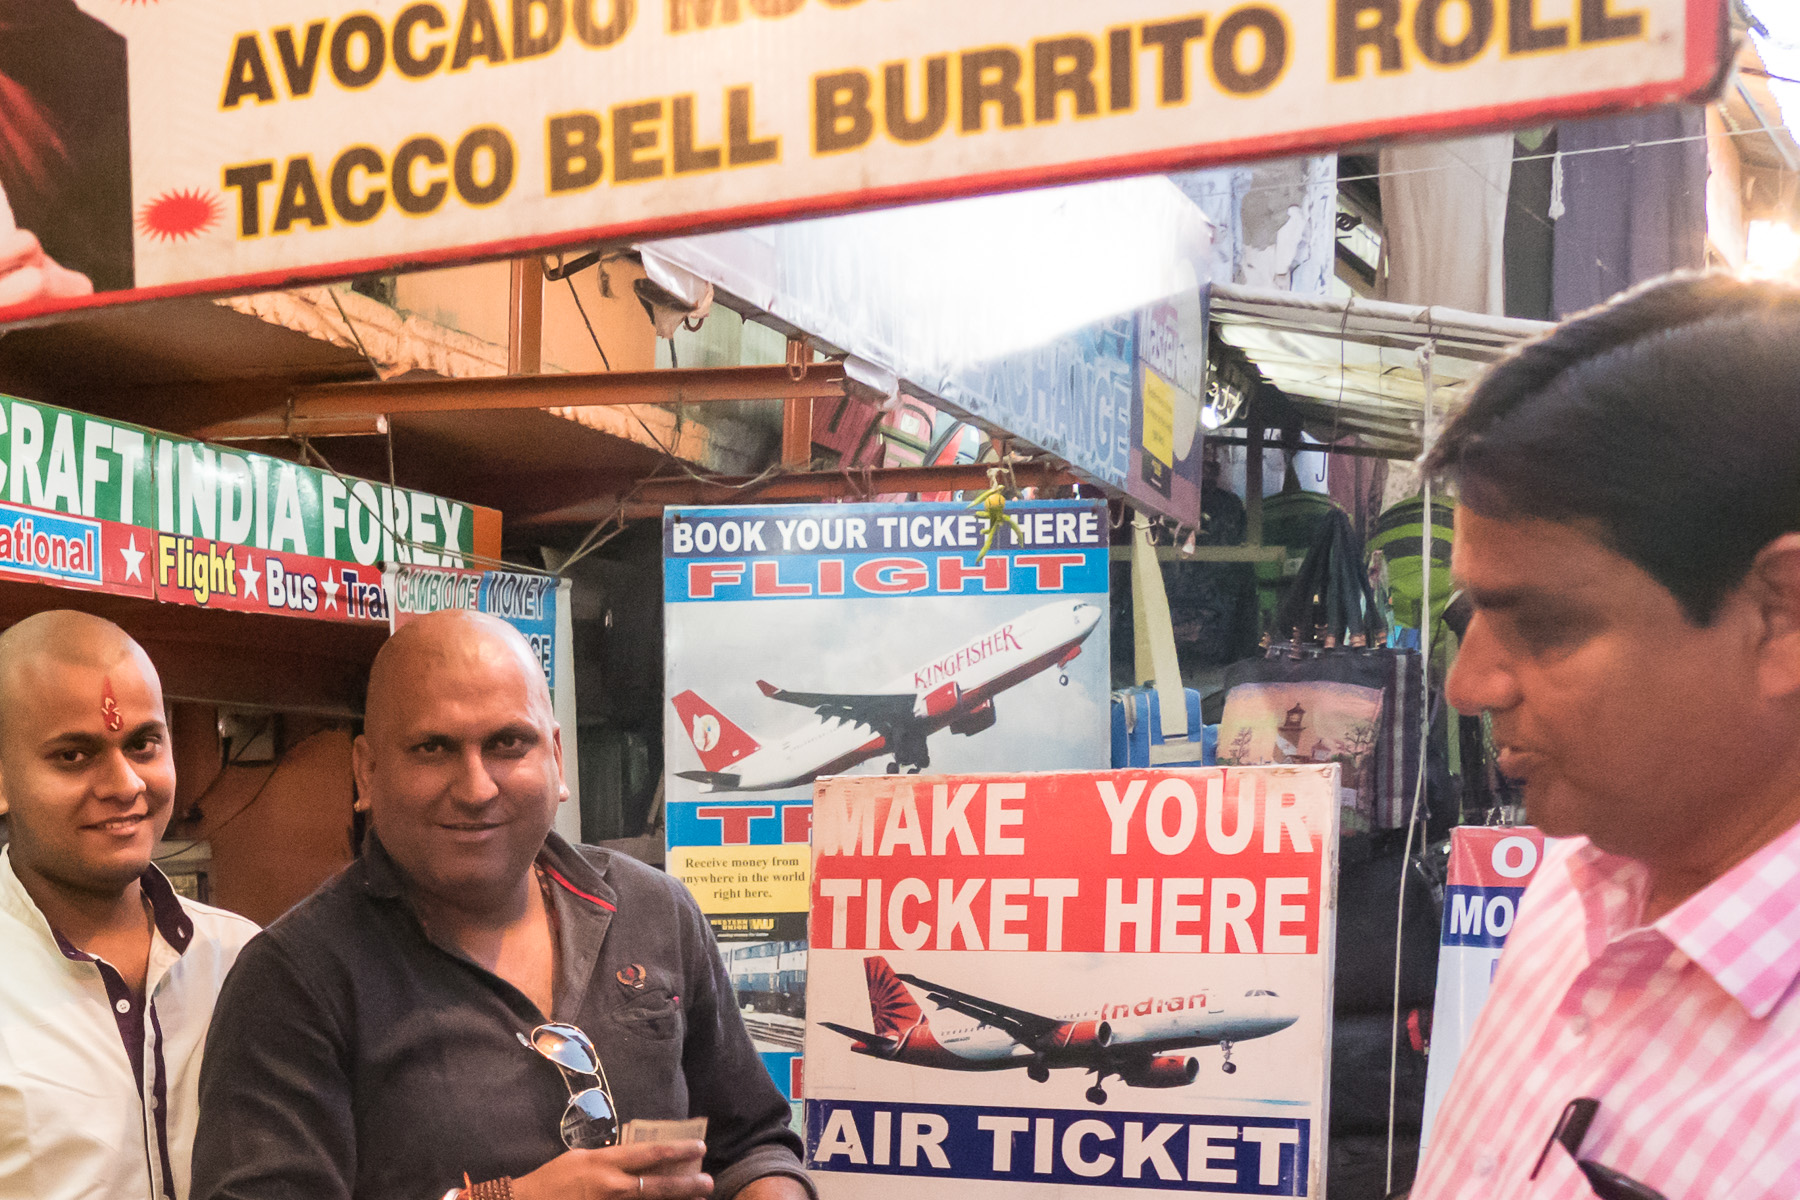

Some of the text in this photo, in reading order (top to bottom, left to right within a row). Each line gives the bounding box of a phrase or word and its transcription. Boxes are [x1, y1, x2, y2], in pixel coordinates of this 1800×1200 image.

[218, 0, 639, 111] AVOCADO
[223, 0, 1649, 241] TACCO BELL BURRITO ROLL
[156, 438, 310, 555] INDIA
[322, 472, 466, 569] FOREX
[672, 511, 1100, 555] BOOK YOUR TICKET HERE
[158, 535, 238, 605] Flight
[265, 557, 319, 614] Bus
[487, 572, 552, 620] MONEY
[686, 552, 1088, 599] FLIGHT
[912, 622, 1024, 692] KINGFISHER
[822, 776, 1316, 858] MAKE YOUR
[685, 856, 799, 869] Receive money from
[713, 888, 772, 901] right here.
[737, 874, 747, 882] in
[751, 873, 770, 882] the
[773, 872, 805, 882] world
[819, 875, 1311, 955] TICKET HERE
[1100, 992, 1208, 1021] Indian
[813, 1108, 1301, 1189] AIR TICKET
